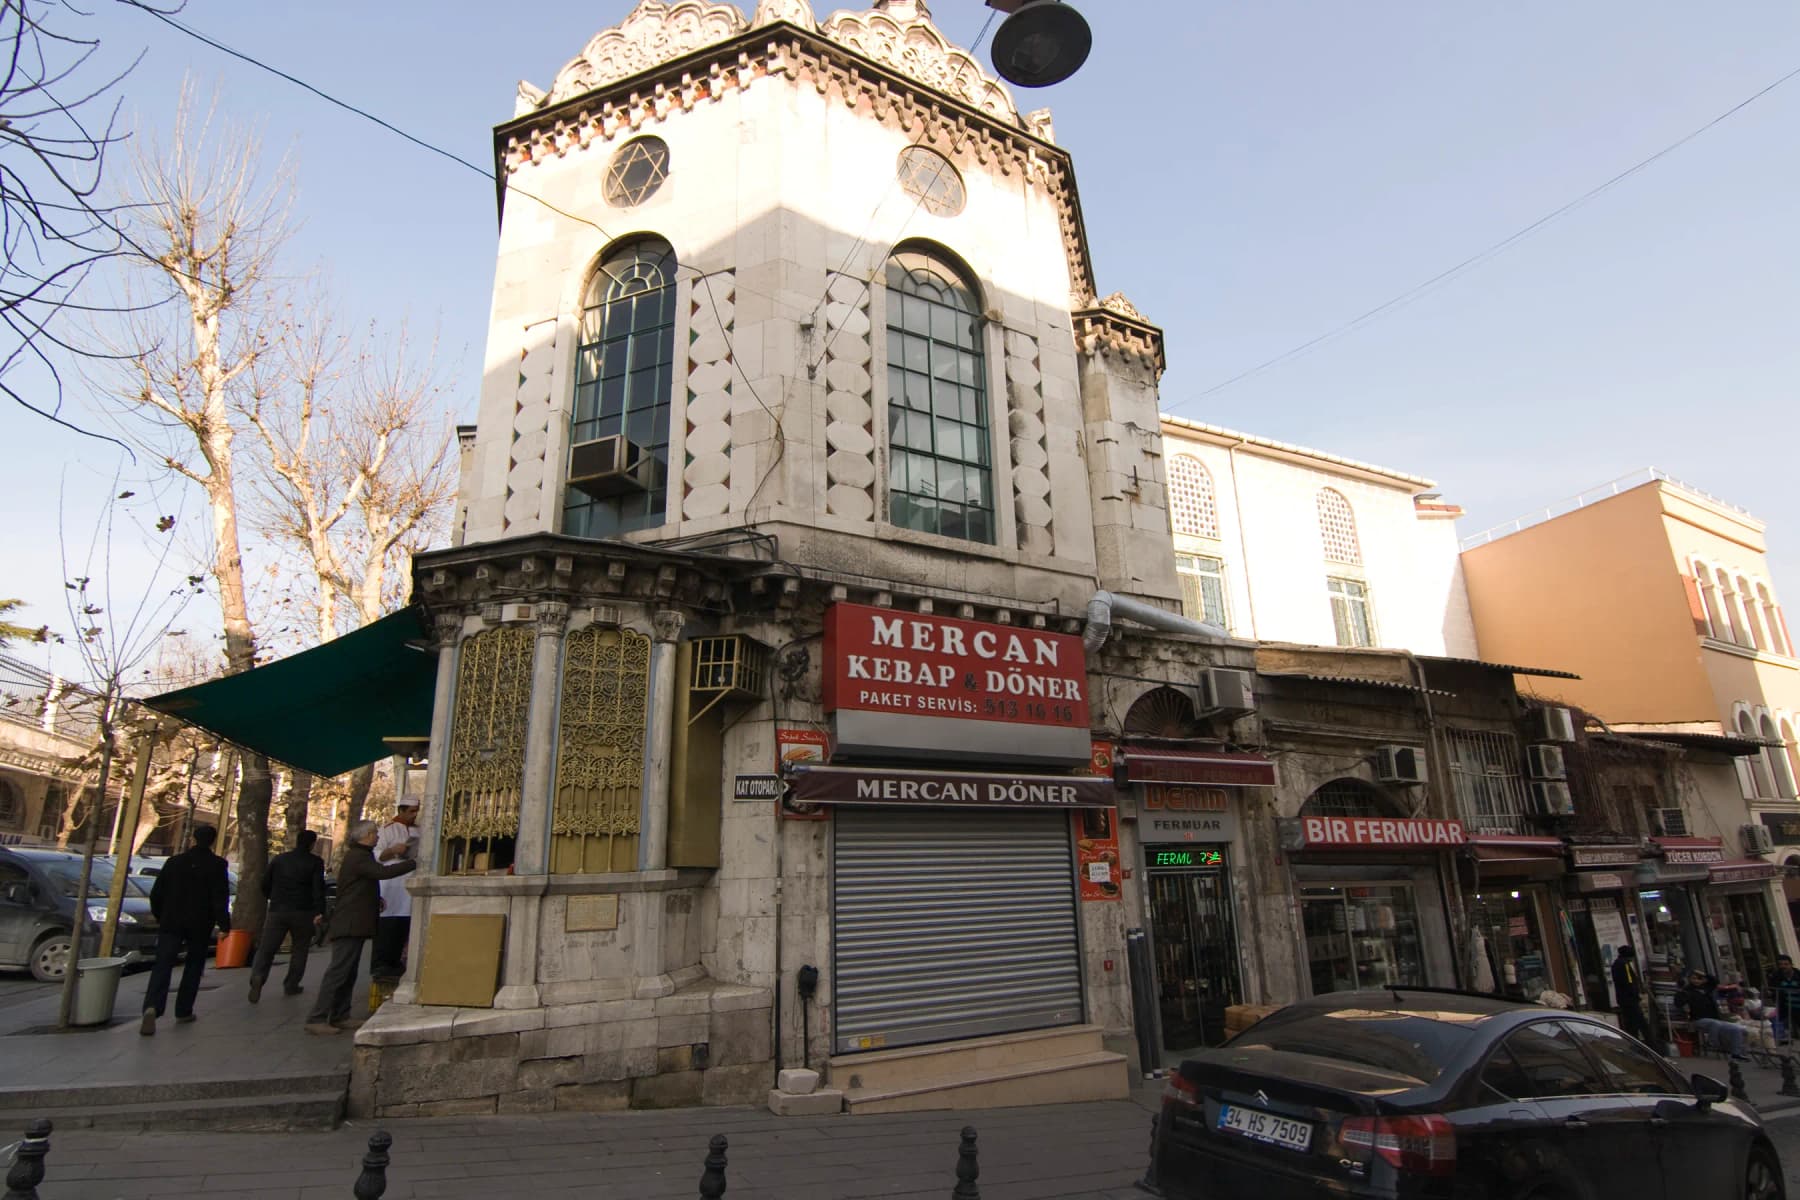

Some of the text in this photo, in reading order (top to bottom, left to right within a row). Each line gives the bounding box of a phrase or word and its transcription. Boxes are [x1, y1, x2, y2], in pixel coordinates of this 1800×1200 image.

[871, 615, 1059, 667] MERCAN
[847, 655, 1082, 701] KEBAP & DÖNER
[860, 690, 912, 708] PAKET
[917, 693, 979, 713] SERVİS:
[735, 779, 750, 796] KAT
[856, 778, 1078, 803] MERCAN DÖNER
[1153, 819, 1221, 831] FERMUAR
[1306, 816, 1464, 844] BİR FERMUAR
[1226, 1108, 1242, 1127] 34
[1247, 1113, 1267, 1133] HS
[1270, 1119, 1308, 1143] 7509
